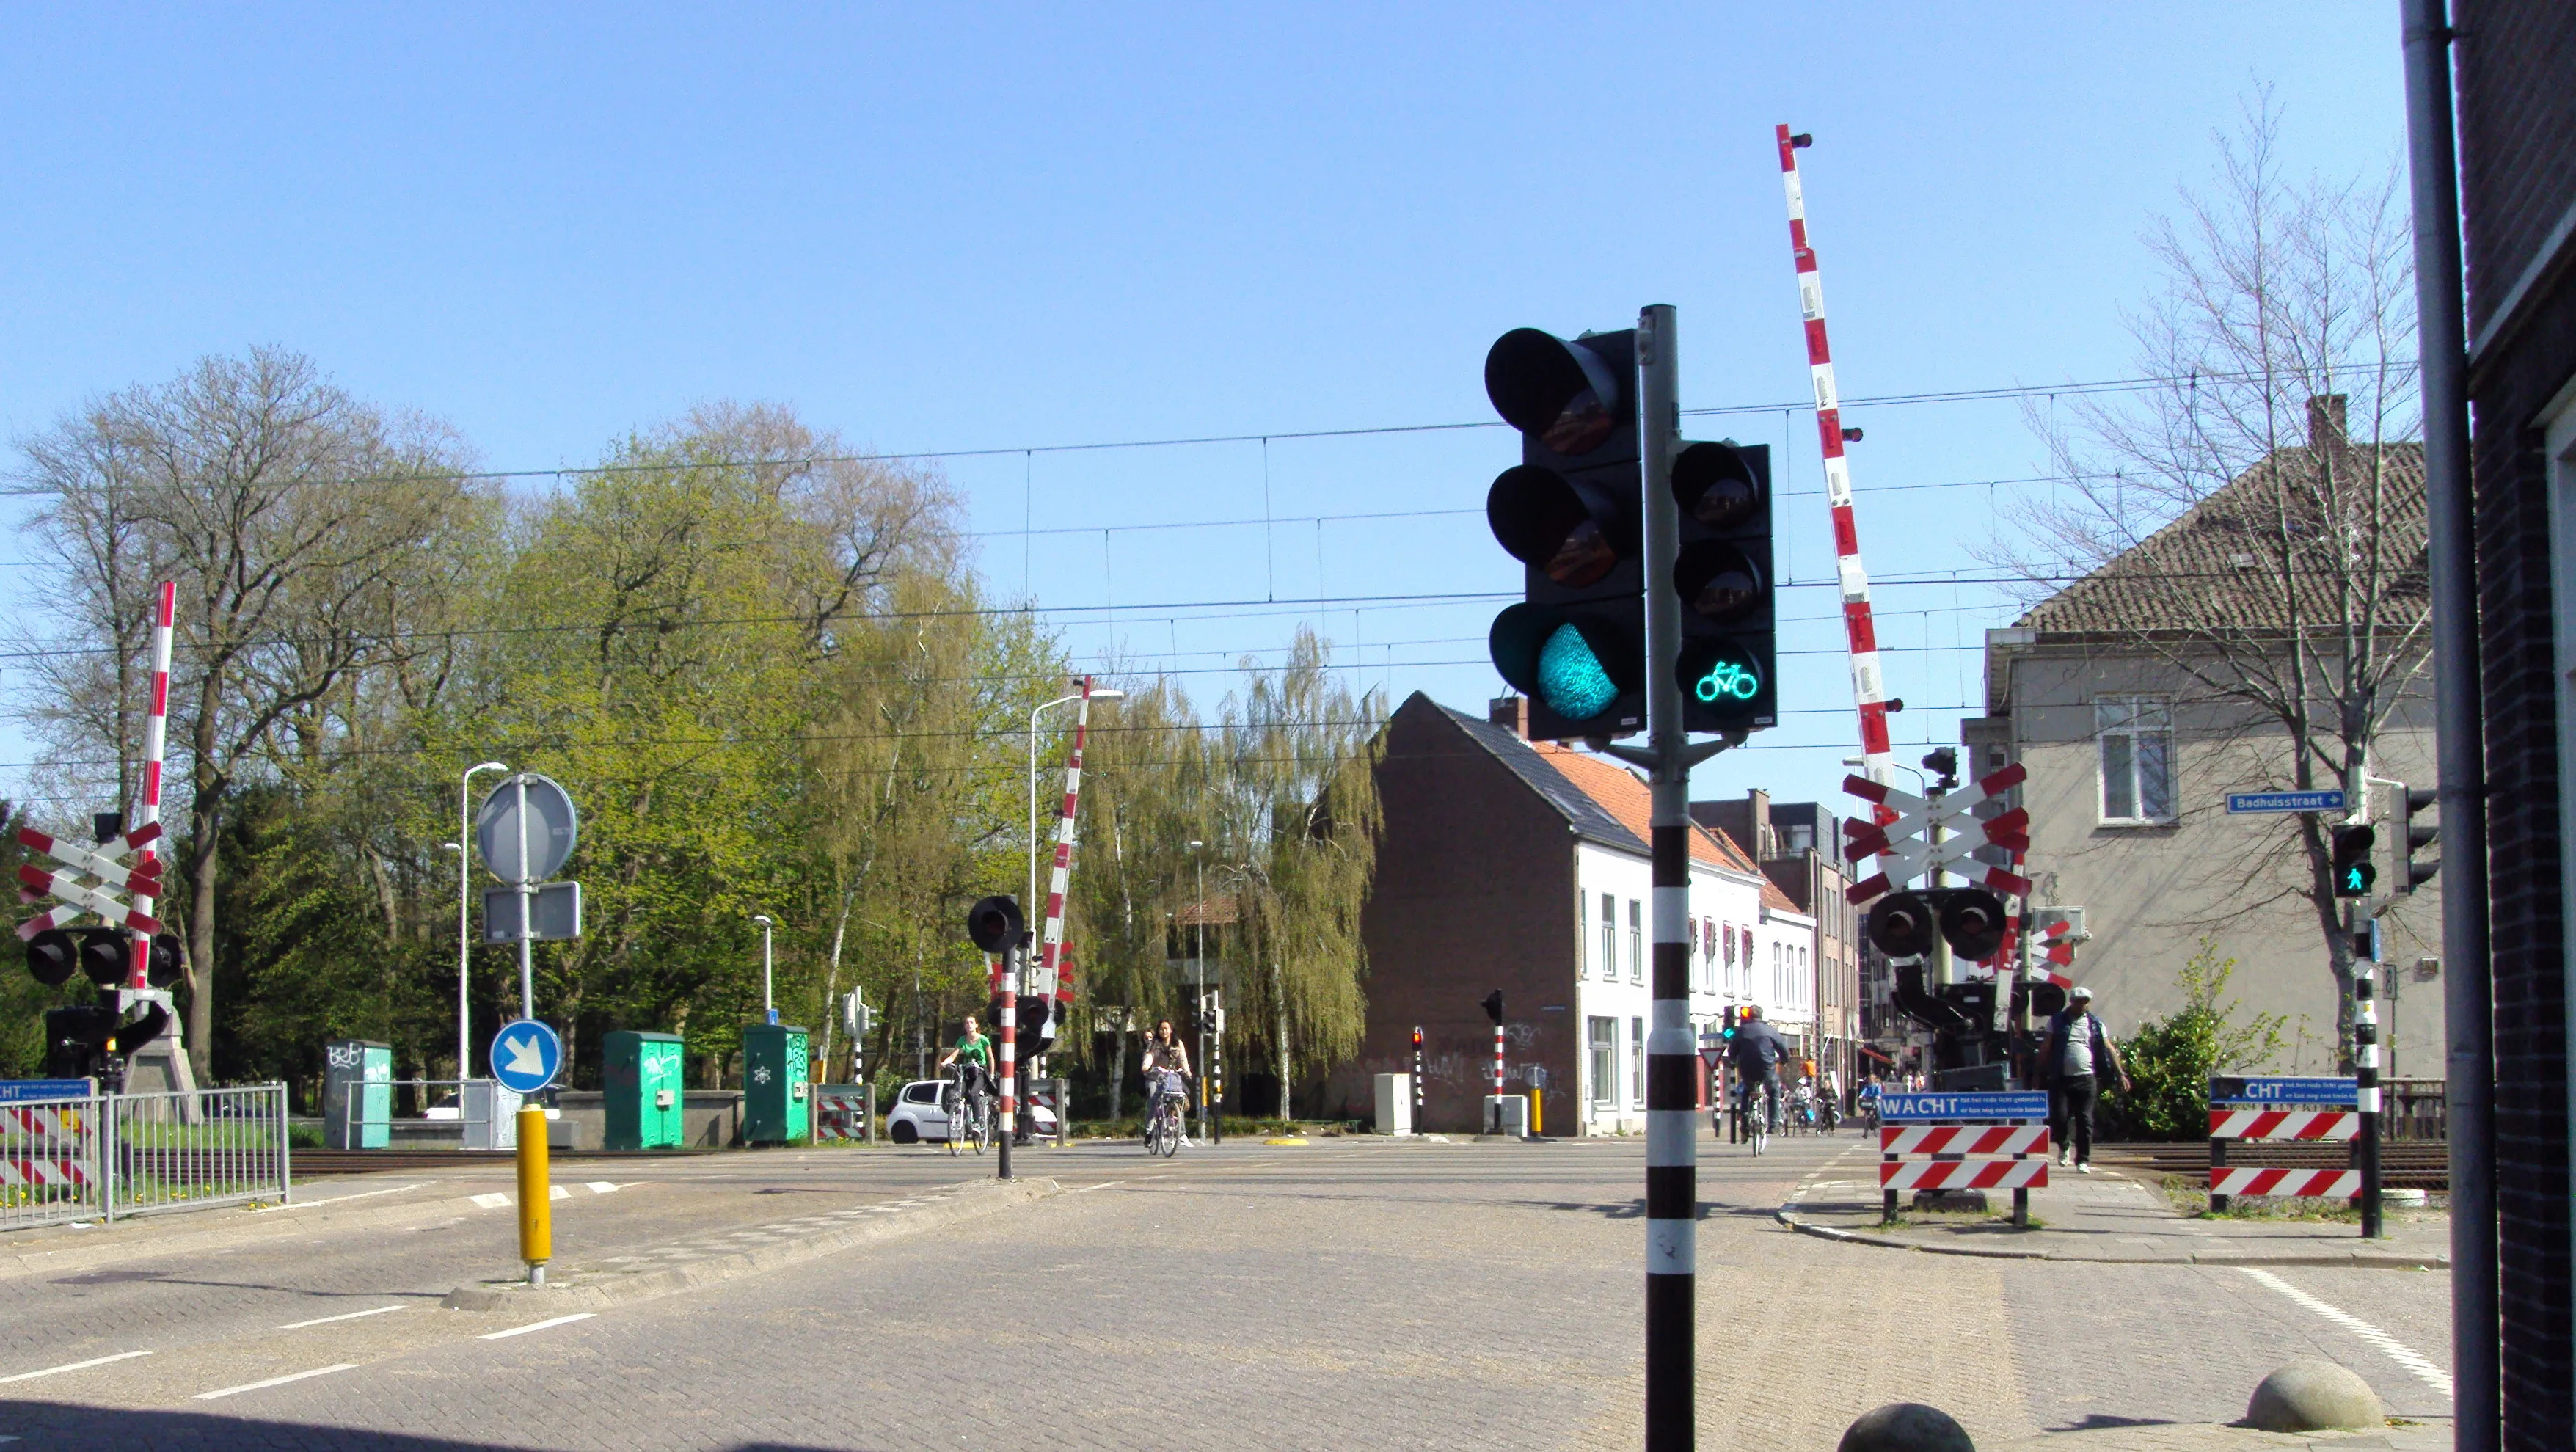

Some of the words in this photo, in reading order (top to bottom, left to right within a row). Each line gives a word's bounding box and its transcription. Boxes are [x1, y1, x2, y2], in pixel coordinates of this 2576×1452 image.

[2237, 795, 2323, 808] Badhuisstraat
[0, 1085, 21, 1098] HT
[2232, 1082, 2283, 1098] CHT
[1883, 1098, 1958, 1114] WACHT
